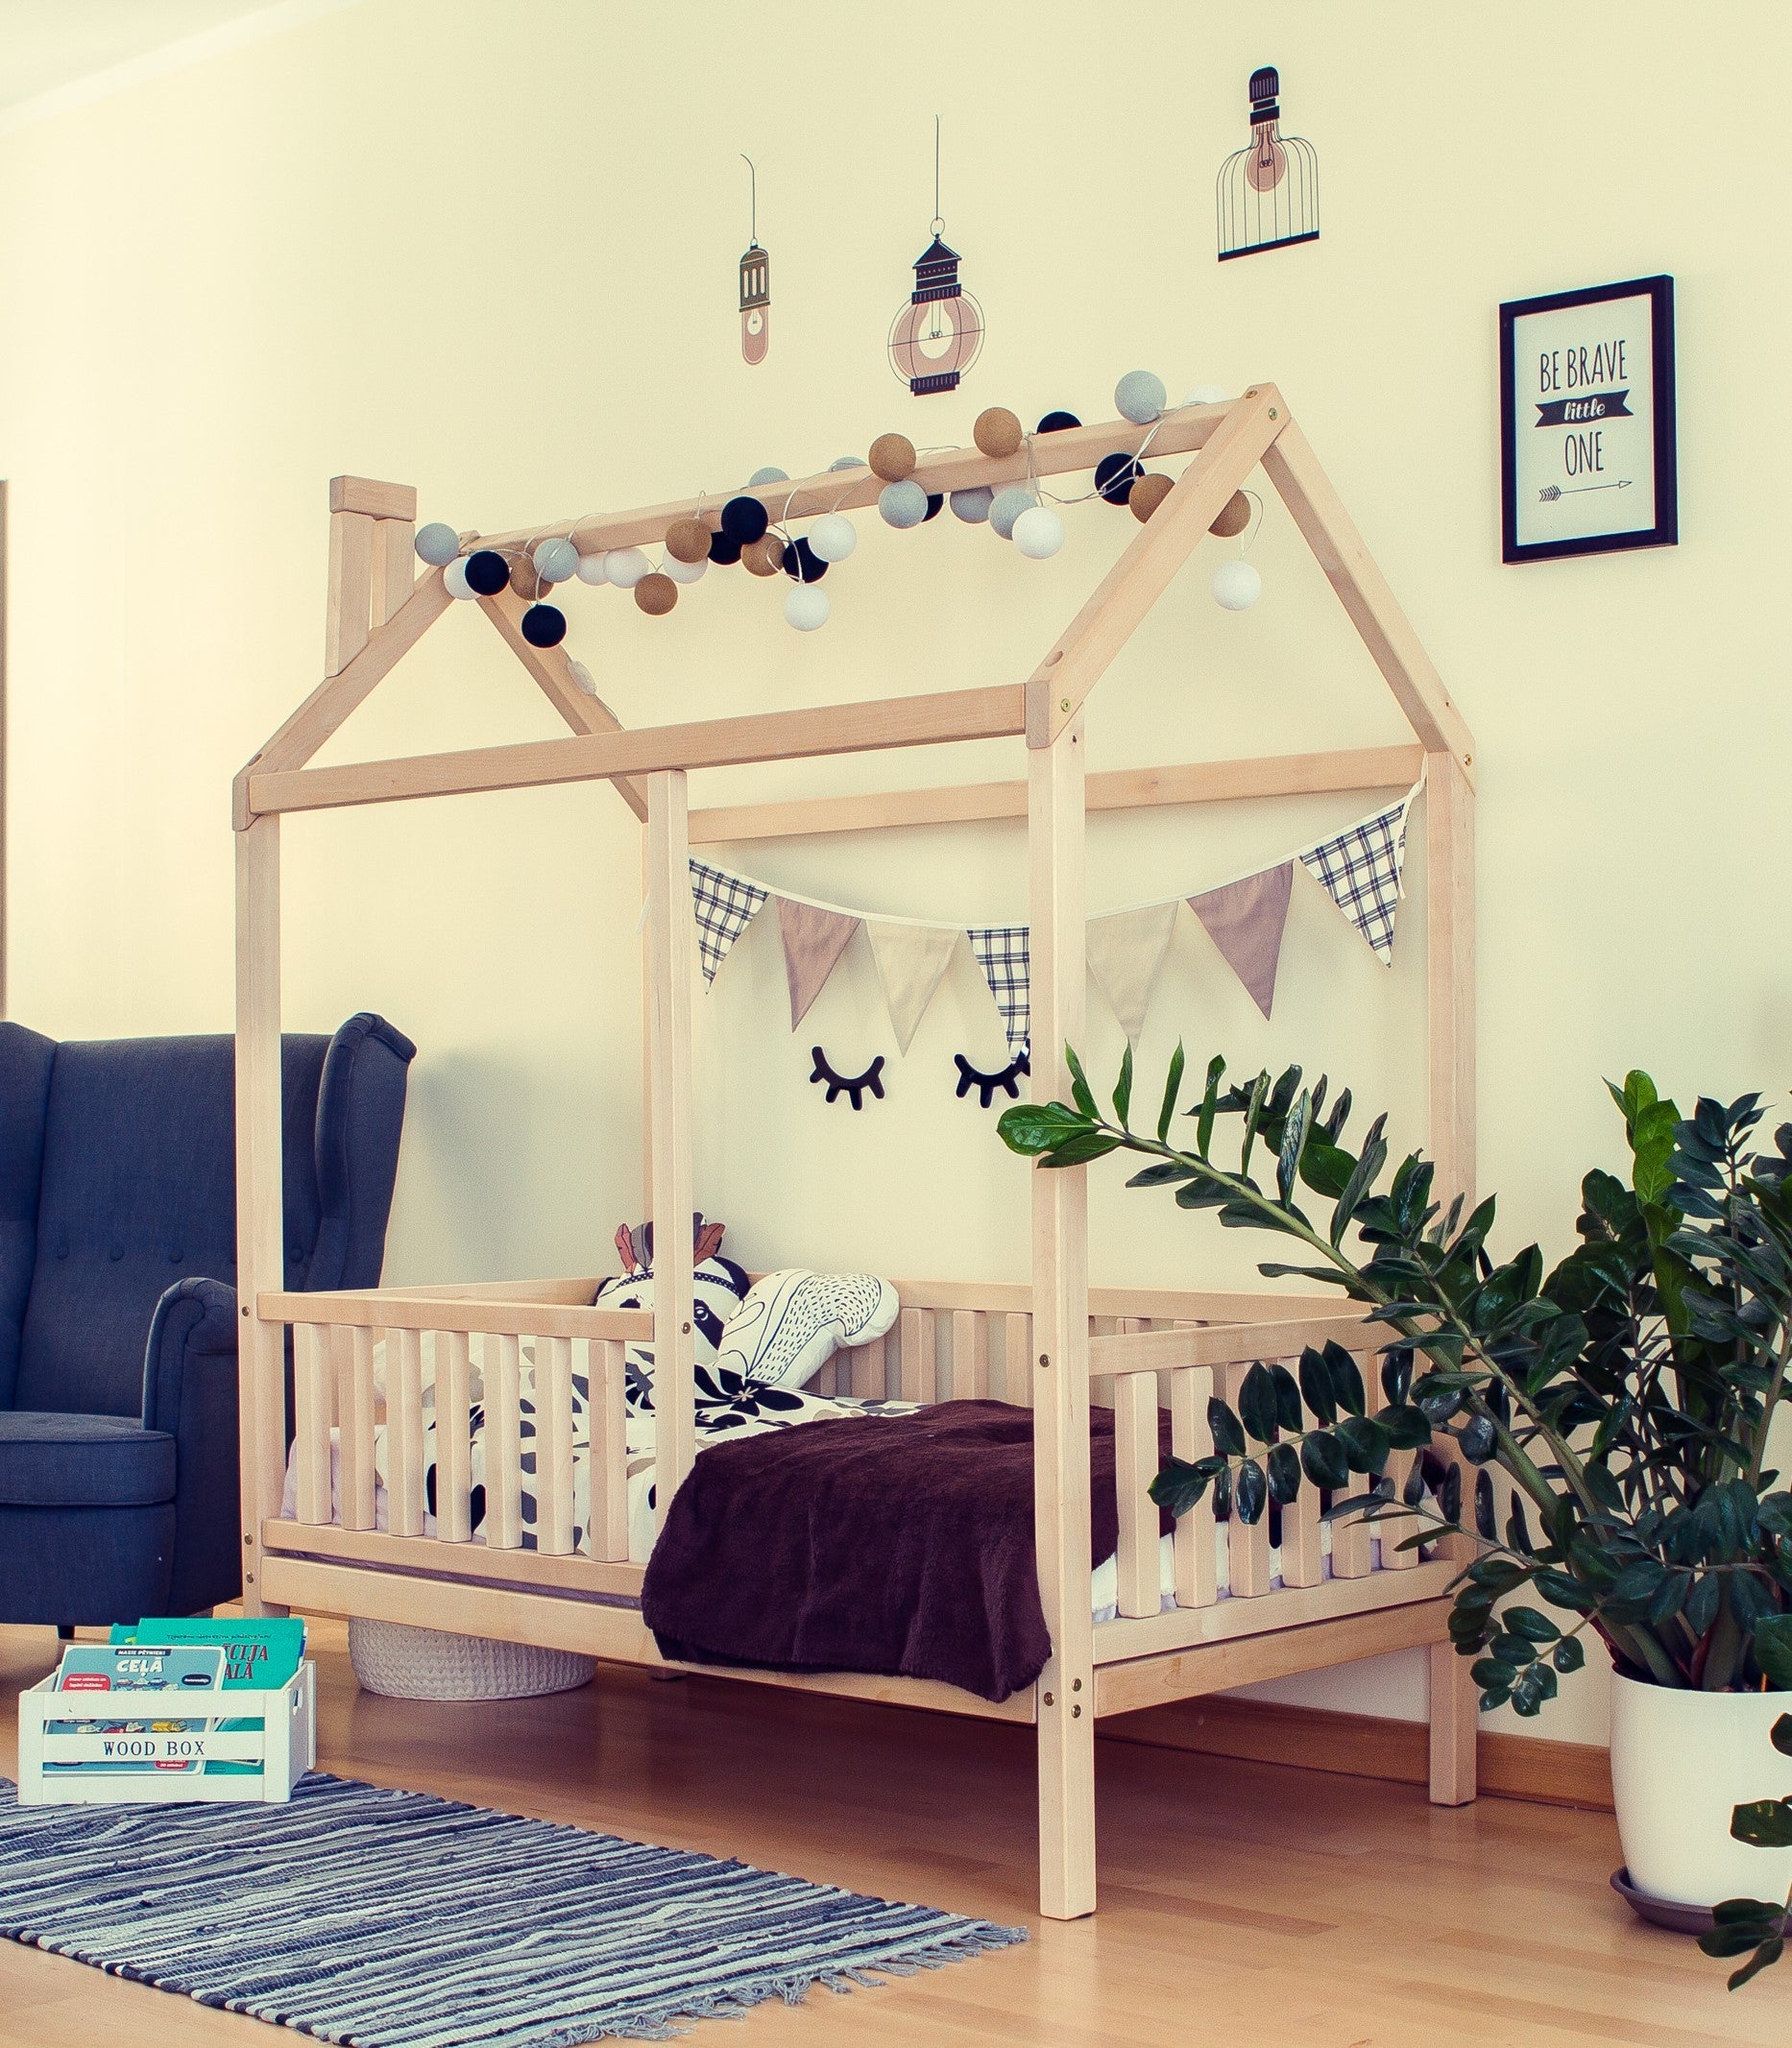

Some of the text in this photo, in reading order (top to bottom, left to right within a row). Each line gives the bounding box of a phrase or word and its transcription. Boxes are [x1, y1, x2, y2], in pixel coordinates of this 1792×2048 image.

[1539, 340, 1628, 393] BE BRAVE
[1563, 398, 1606, 422] little
[1564, 431, 1605, 476] ONE
[103, 1741, 205, 1756] WOOD BOX
